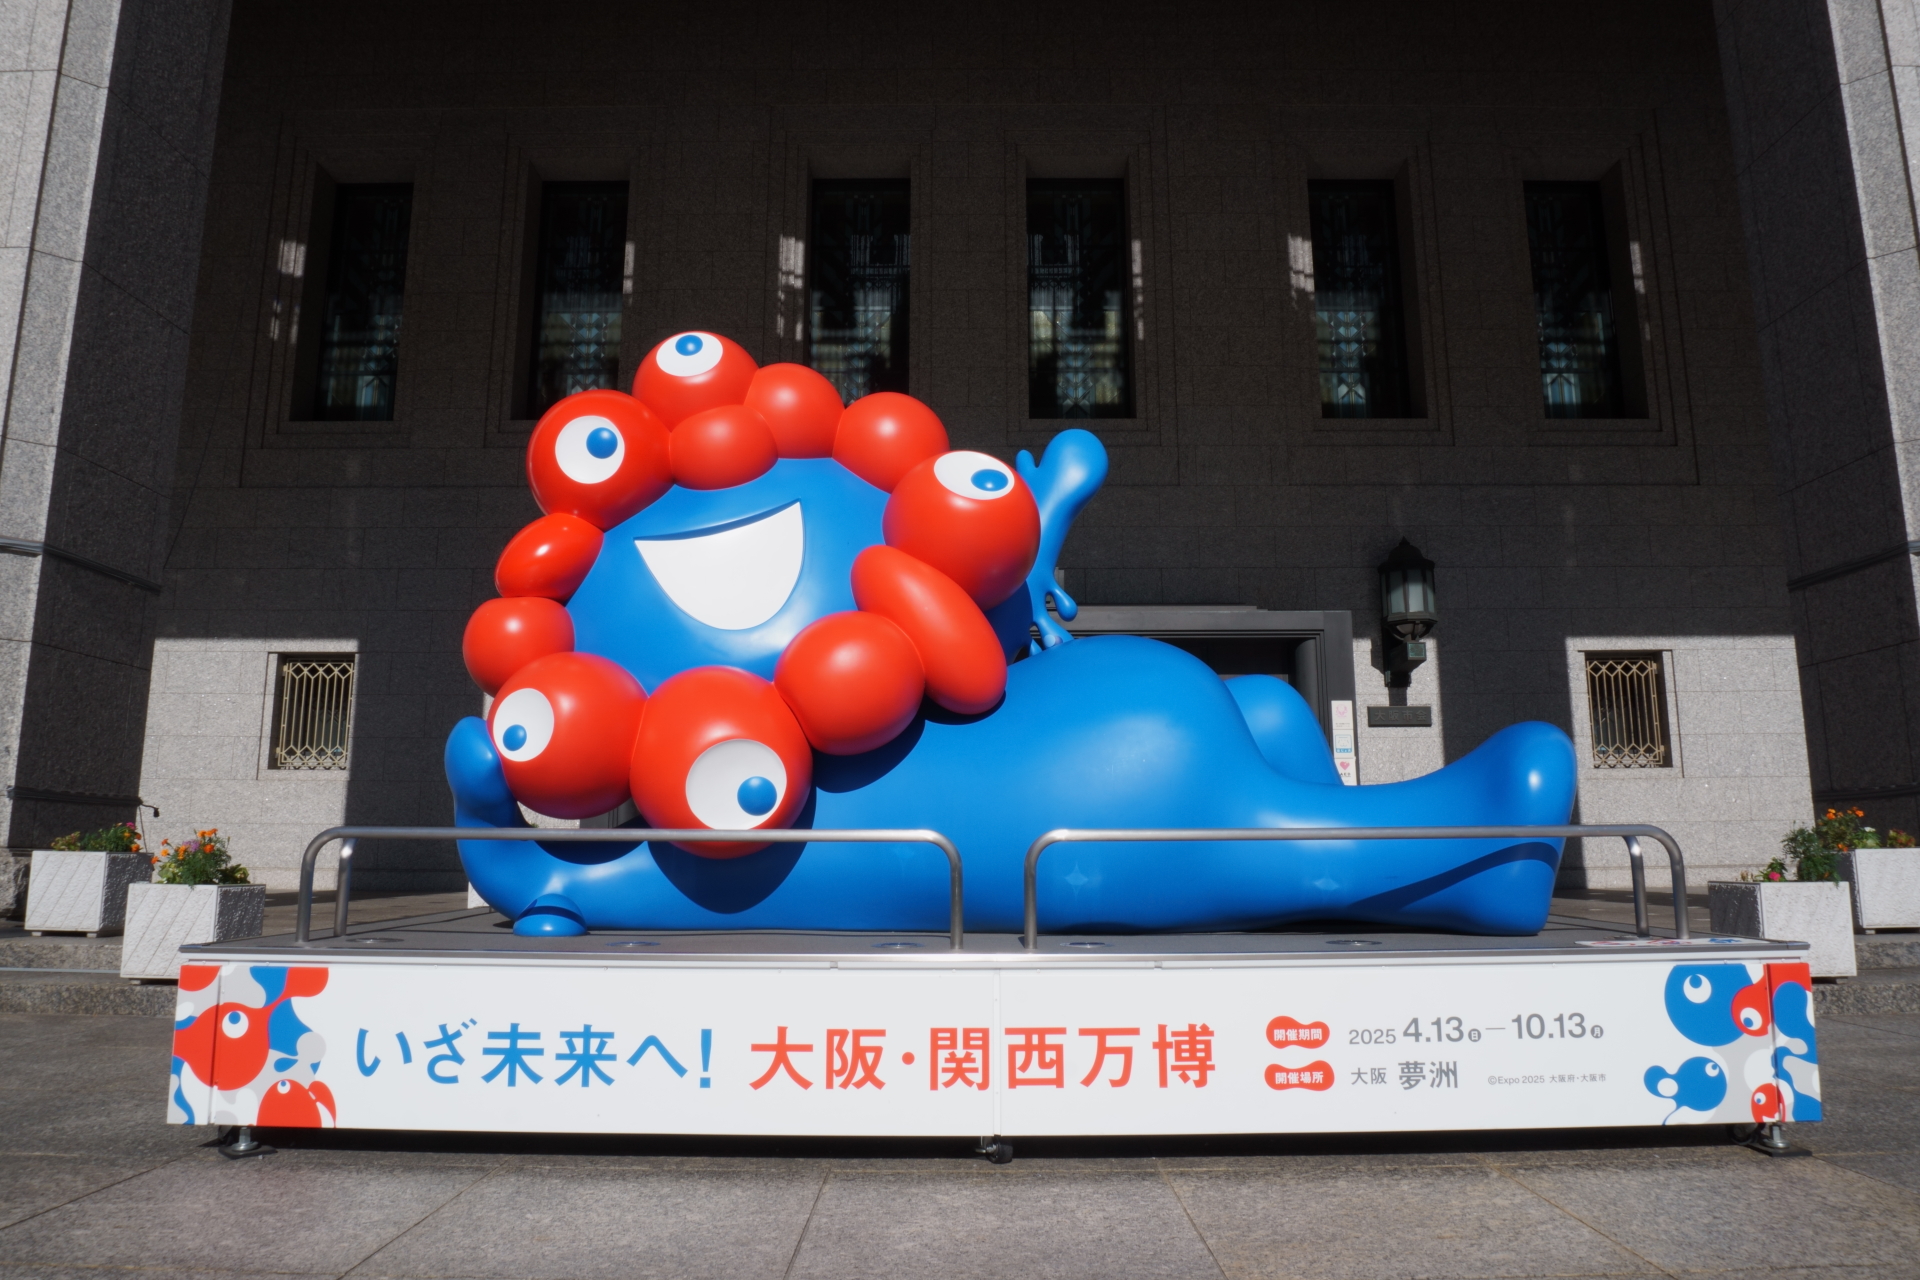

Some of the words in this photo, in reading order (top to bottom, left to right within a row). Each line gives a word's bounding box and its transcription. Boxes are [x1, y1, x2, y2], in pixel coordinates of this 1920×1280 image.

[1374, 709, 1427, 722] 大阪市会
[1273, 1028, 1323, 1042] 開催期間
[1349, 1028, 1397, 1045] 2025
[1274, 1071, 1324, 1085] 開催場所
[1350, 1067, 1388, 1085] 大阪
[1398, 1060, 1459, 1091] 夢洲
[1521, 1075, 1545, 1084] 2025
